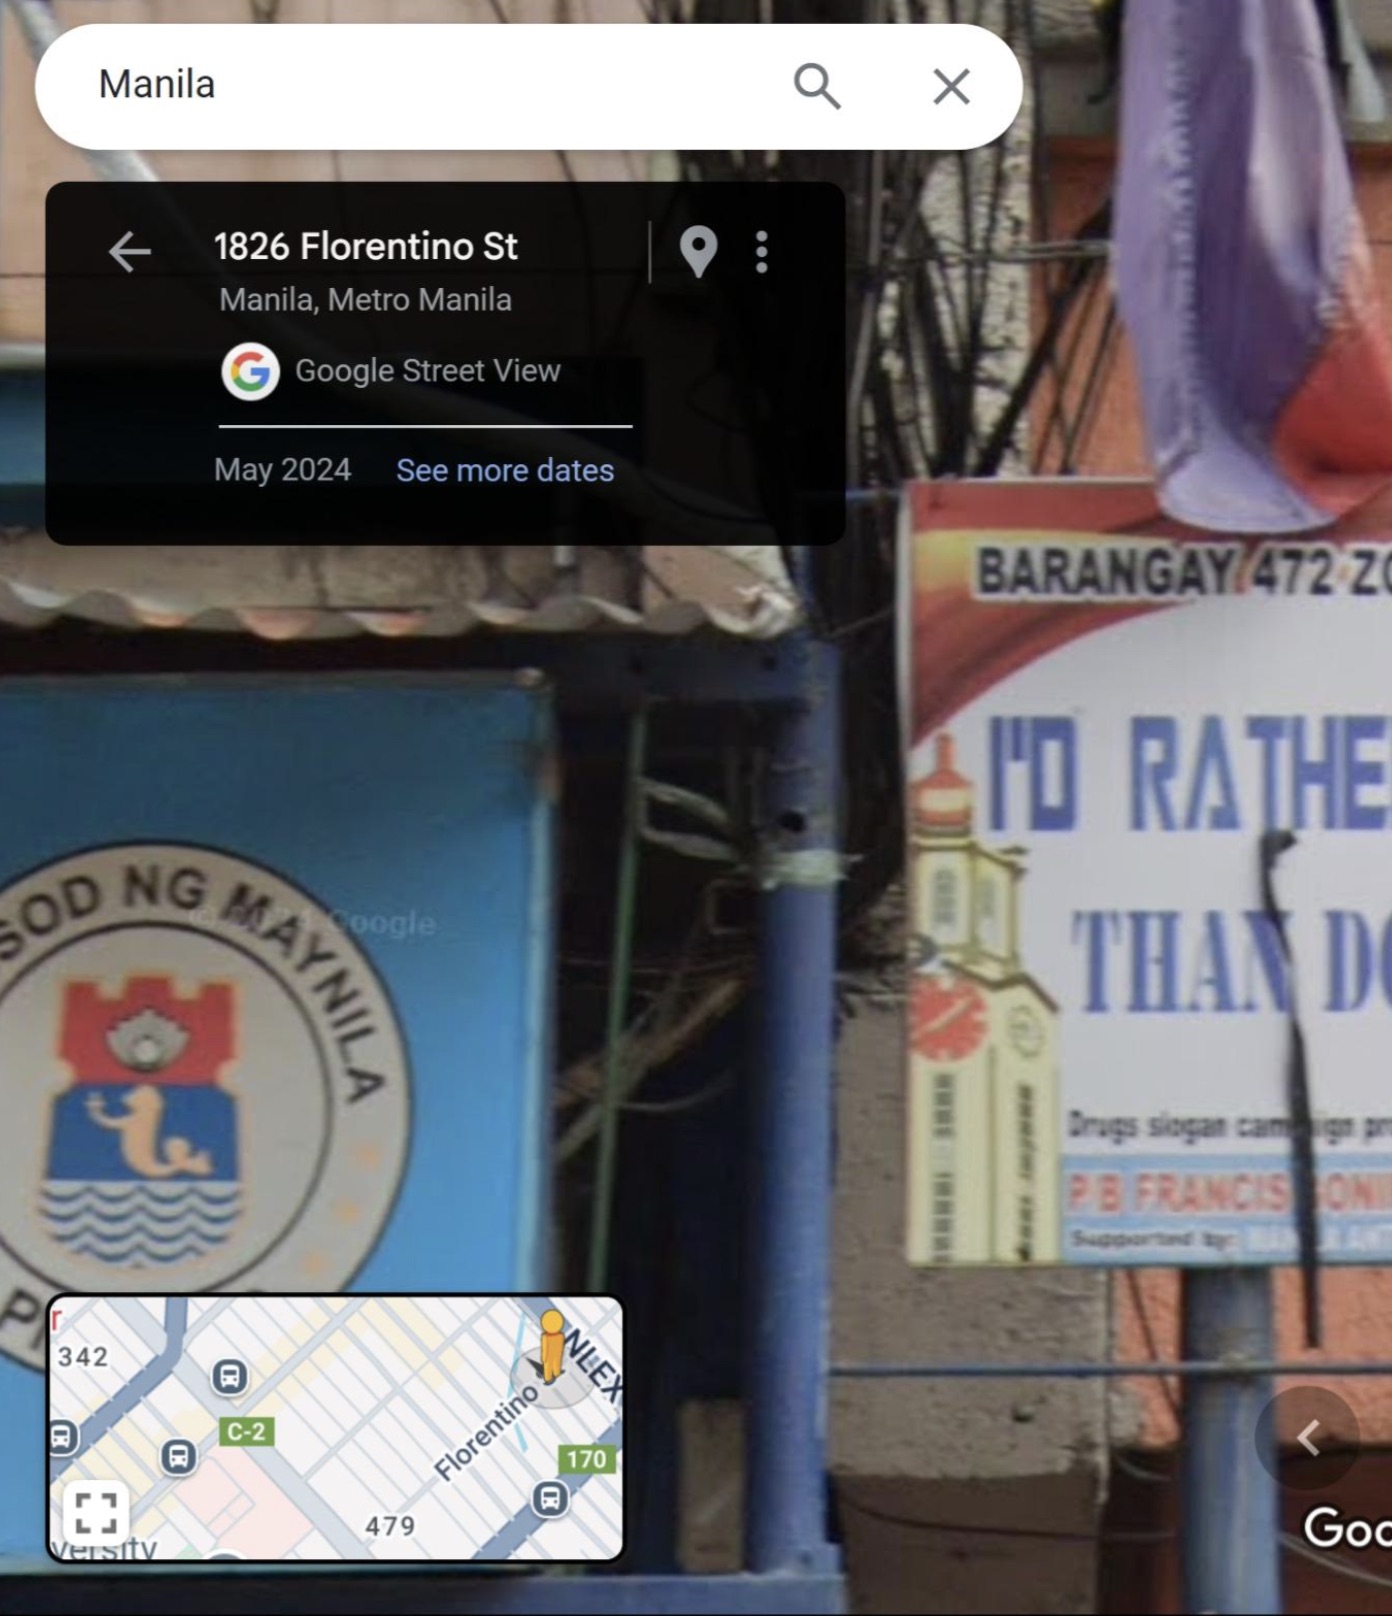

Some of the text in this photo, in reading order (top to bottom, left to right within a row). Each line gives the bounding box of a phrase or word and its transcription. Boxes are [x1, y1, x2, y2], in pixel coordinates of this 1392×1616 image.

[976, 546, 1237, 597] BARANGAY
[1251, 548, 1334, 597] 472
[988, 715, 1077, 831] I'D
[123, 864, 208, 911] NG
[219, 883, 386, 1106] MAYNILA
[1072, 909, 1297, 1014] THAN
[1068, 1109, 1139, 1146] Drugs
[1148, 1109, 1227, 1146] slogan
[1237, 1109, 1354, 1146] camign
[1135, 1172, 1289, 1214] FRANCIS
